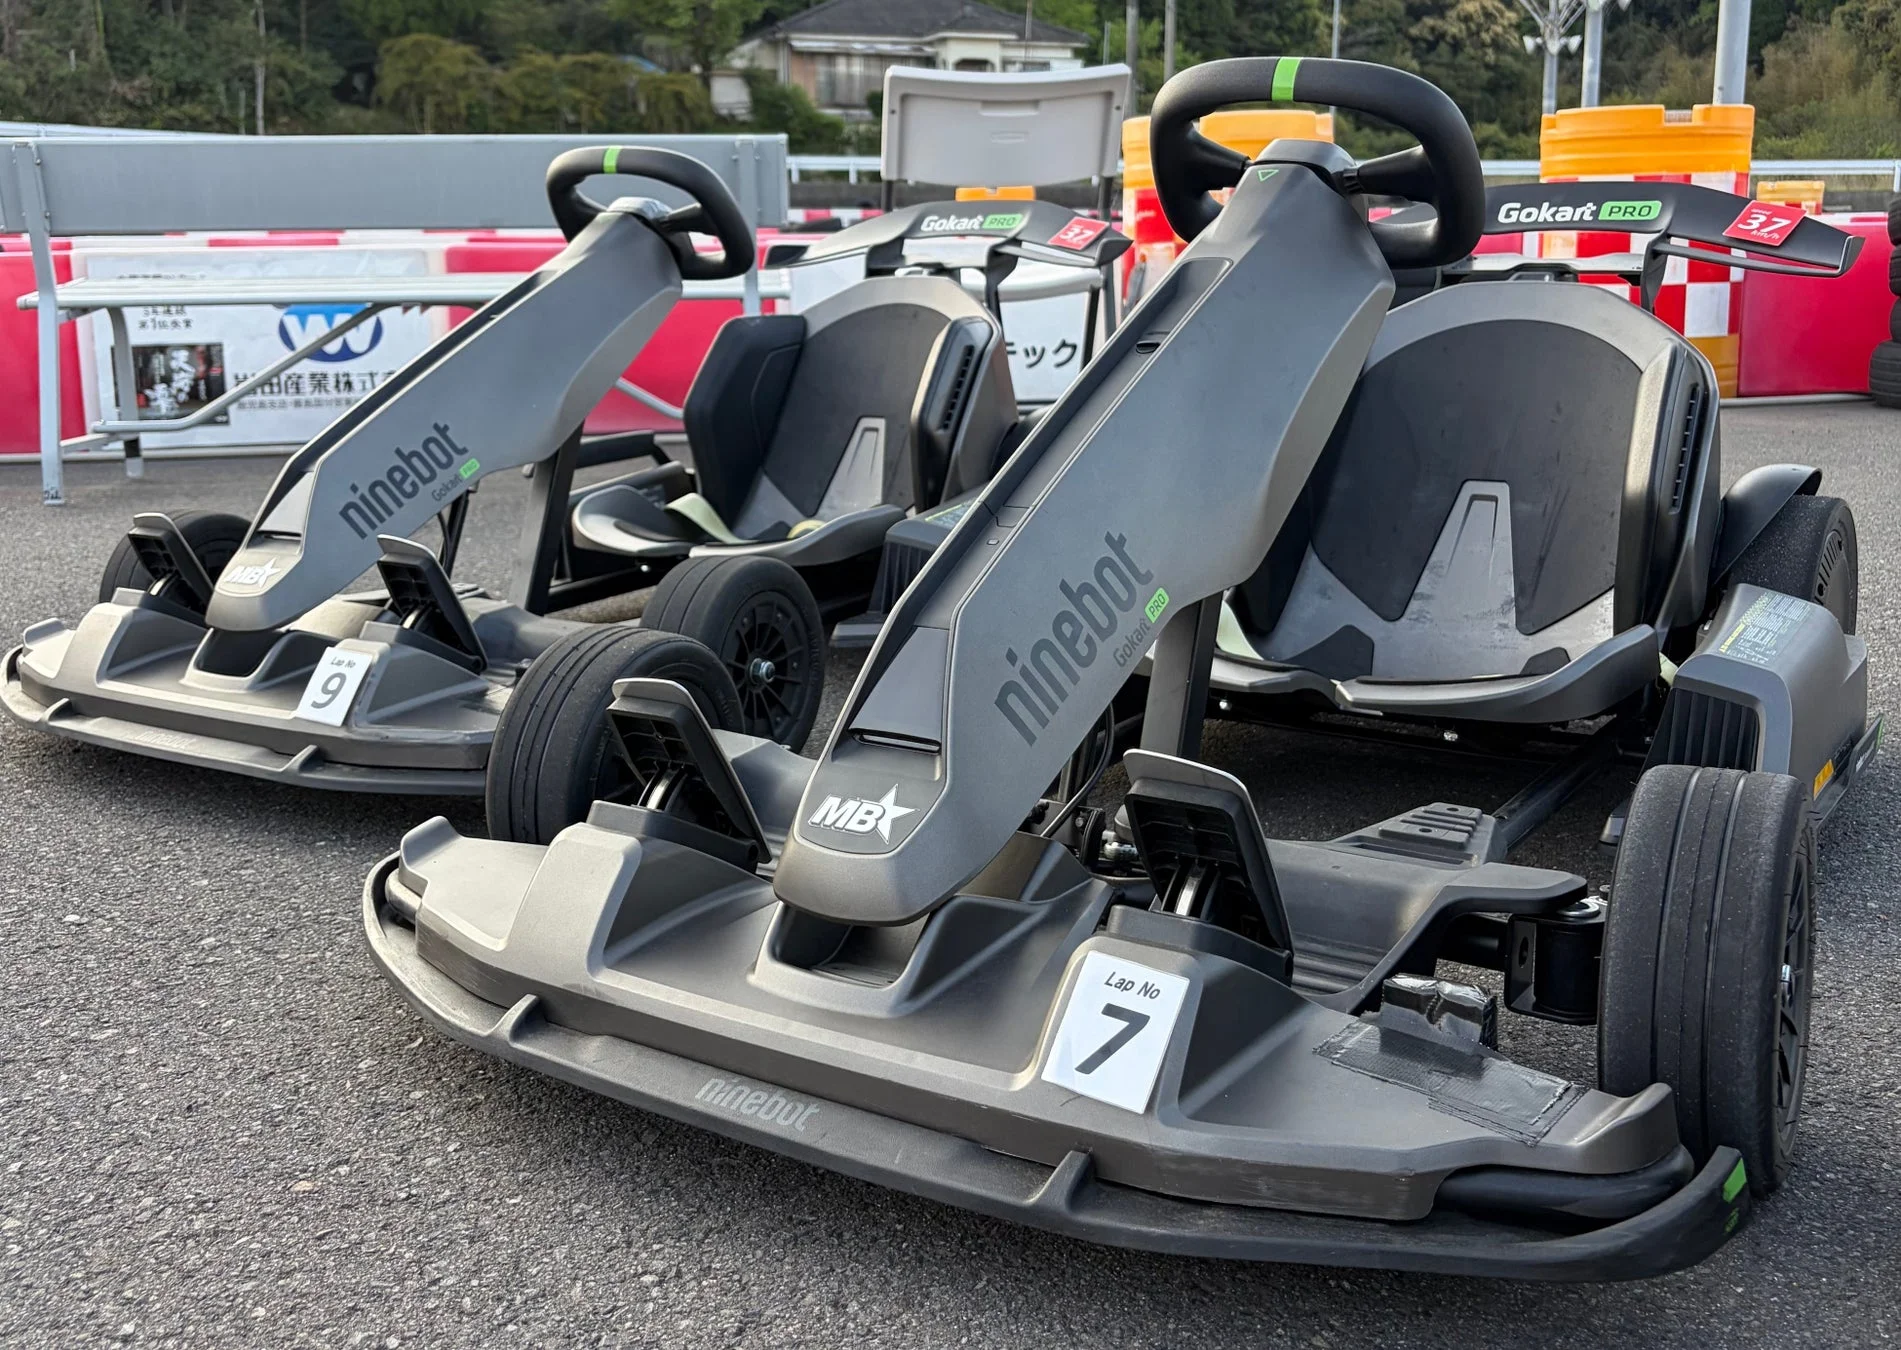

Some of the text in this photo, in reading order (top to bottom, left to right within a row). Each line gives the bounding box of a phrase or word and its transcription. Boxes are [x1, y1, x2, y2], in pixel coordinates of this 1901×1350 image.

[920, 215, 1019, 232] Gokart PRO
[1497, 202, 1653, 224] Gokart PRO
[1737, 213, 1792, 234] 37
[1059, 227, 1094, 241] 37
[339, 422, 469, 540] ninebot
[224, 566, 264, 584] MB
[994, 531, 1154, 747] ninebot
[1113, 592, 1167, 668] Gokart PRO
[310, 672, 347, 709] 9
[808, 794, 886, 835] MB
[1104, 971, 1161, 1000] Lap No
[1074, 1002, 1151, 1075] 7
[695, 1077, 820, 1132] ninebot
